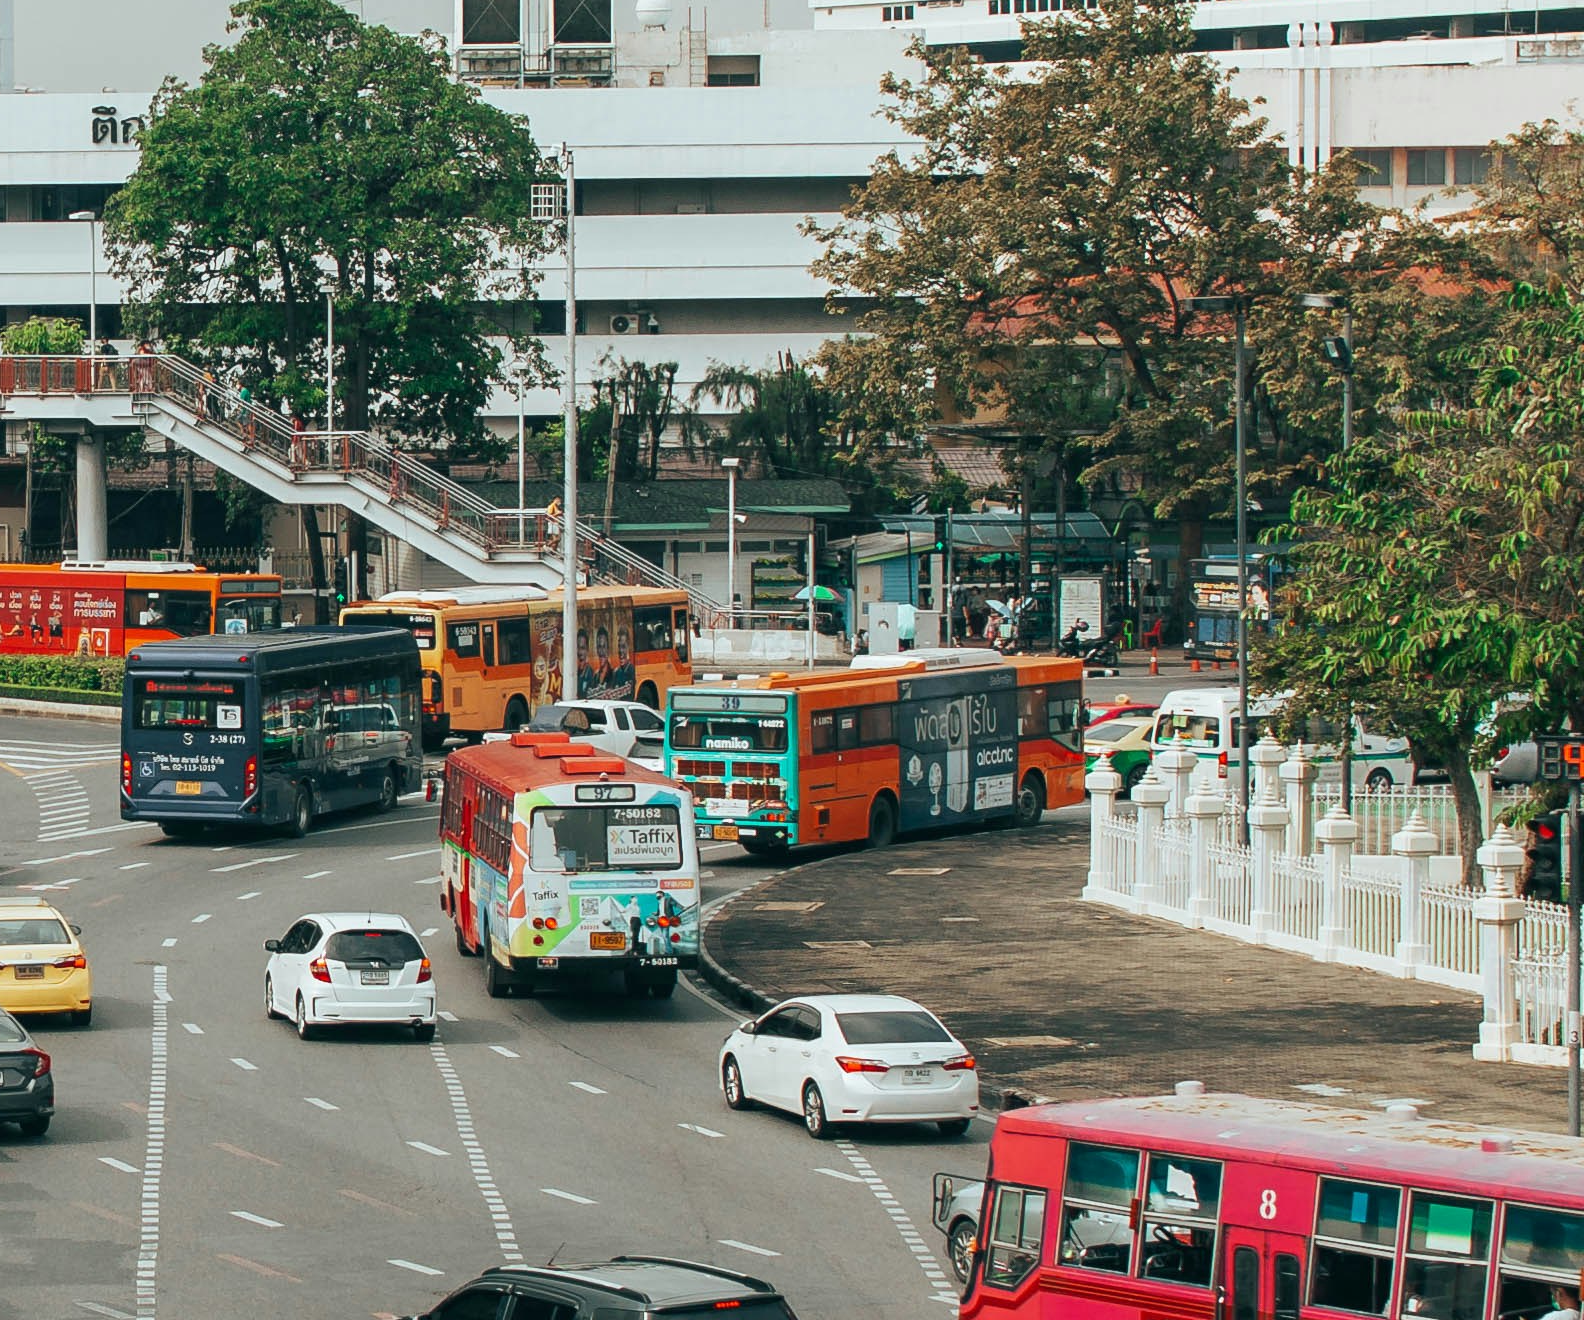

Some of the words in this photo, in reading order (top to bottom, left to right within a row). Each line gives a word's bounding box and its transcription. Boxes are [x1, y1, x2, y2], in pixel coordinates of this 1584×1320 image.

[721, 696, 741, 710] 39
[209, 735, 228, 744] 2-38
[229, 734, 246, 745] (27)
[705, 737, 749, 750] namiko
[593, 787, 614, 800] 97
[613, 808, 662, 819] 7-50182
[628, 828, 676, 844] Taffix
[613, 844, 674, 857] สเปรย์พ่นจมูก
[532, 891, 559, 901] Taffix
[639, 957, 679, 967] 7-50182
[1259, 1189, 1277, 1220] 8
